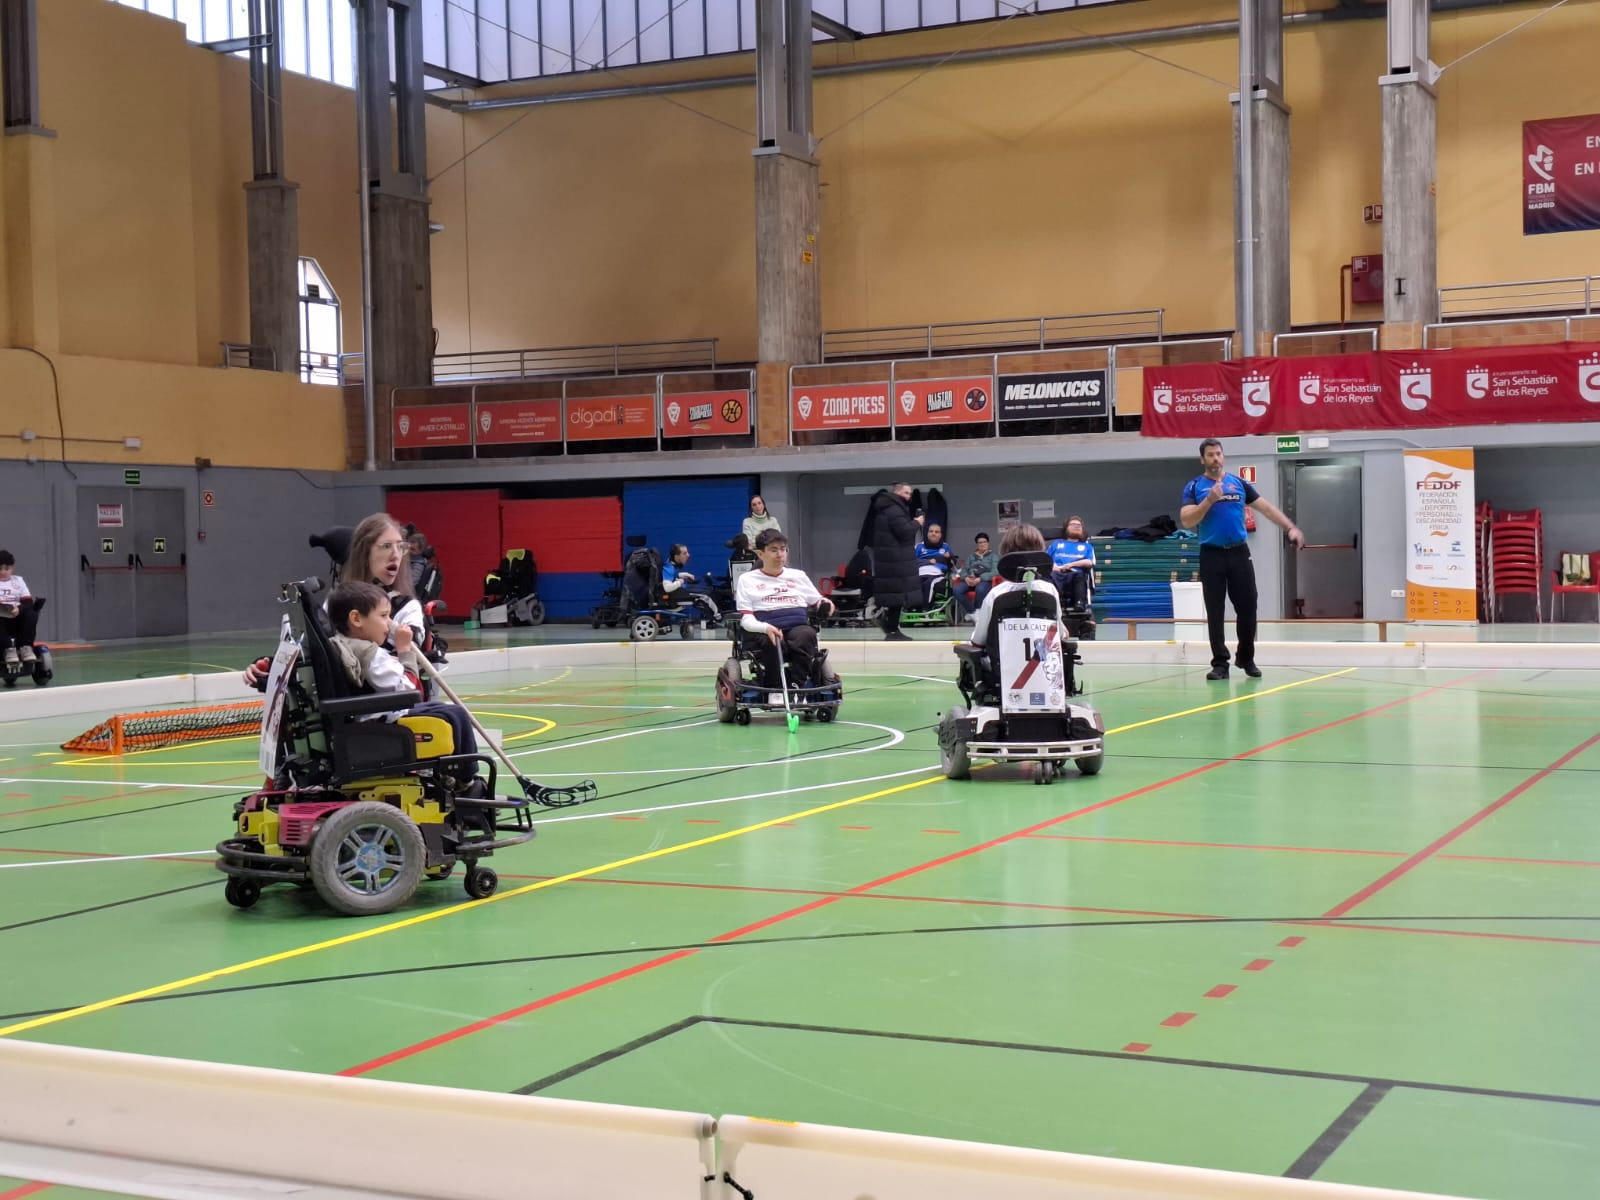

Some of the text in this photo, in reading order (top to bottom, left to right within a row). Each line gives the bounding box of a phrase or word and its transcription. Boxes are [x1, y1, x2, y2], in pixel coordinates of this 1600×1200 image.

[1574, 161, 1595, 176] EN
[1528, 182, 1555, 195] FBM
[1492, 374, 1558, 387] San Sebastián
[1004, 379, 1101, 401] MELONKICKS
[1323, 382, 1382, 393] San Sebastián
[1493, 386, 1549, 397] de los Reyes
[1175, 392, 1229, 403] San Sebastián
[1323, 393, 1375, 405] de los Reyes
[822, 395, 886, 417] ZONA PRESS
[1175, 402, 1222, 413] de los Reyes
[1416, 480, 1462, 491] FEDDF
[1019, 623, 1029, 631] LA
